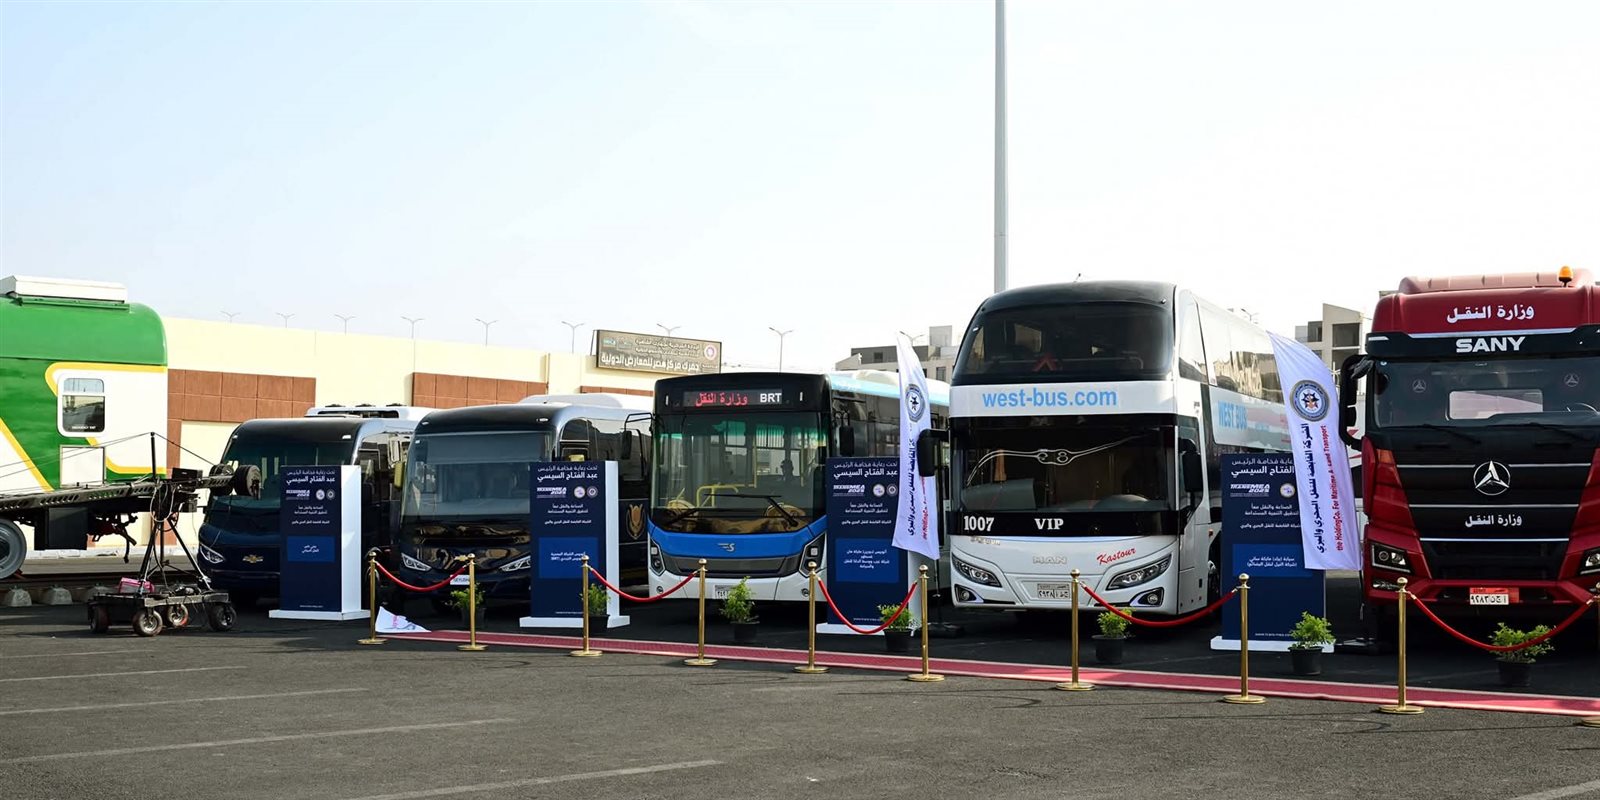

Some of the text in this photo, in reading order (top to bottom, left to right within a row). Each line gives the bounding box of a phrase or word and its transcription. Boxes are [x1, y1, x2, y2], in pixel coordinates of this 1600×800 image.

[1447, 304, 1534, 323] وزارة النقل
[1456, 337, 1525, 353] SANY
[695, 391, 748, 407] وزارة النقل
[760, 392, 782, 403] BRT
[982, 387, 1117, 407] west-bus.com
[537, 472, 565, 483] السيسي
[566, 472, 585, 480] الفتاح
[833, 468, 863, 480] السيسي
[864, 468, 885, 478] الفتاح
[1231, 465, 1294, 478] الفتاح السيسي
[1301, 423, 1328, 554] الشركة القابضة للنقل البحري والبري
[963, 515, 995, 532] 1007
[1034, 518, 1064, 530] VIP
[1465, 514, 1523, 528] وزارة النقل
[1335, 541, 1343, 551] the
[1032, 555, 1067, 565] MAN
[1096, 547, 1137, 566] Kastour
